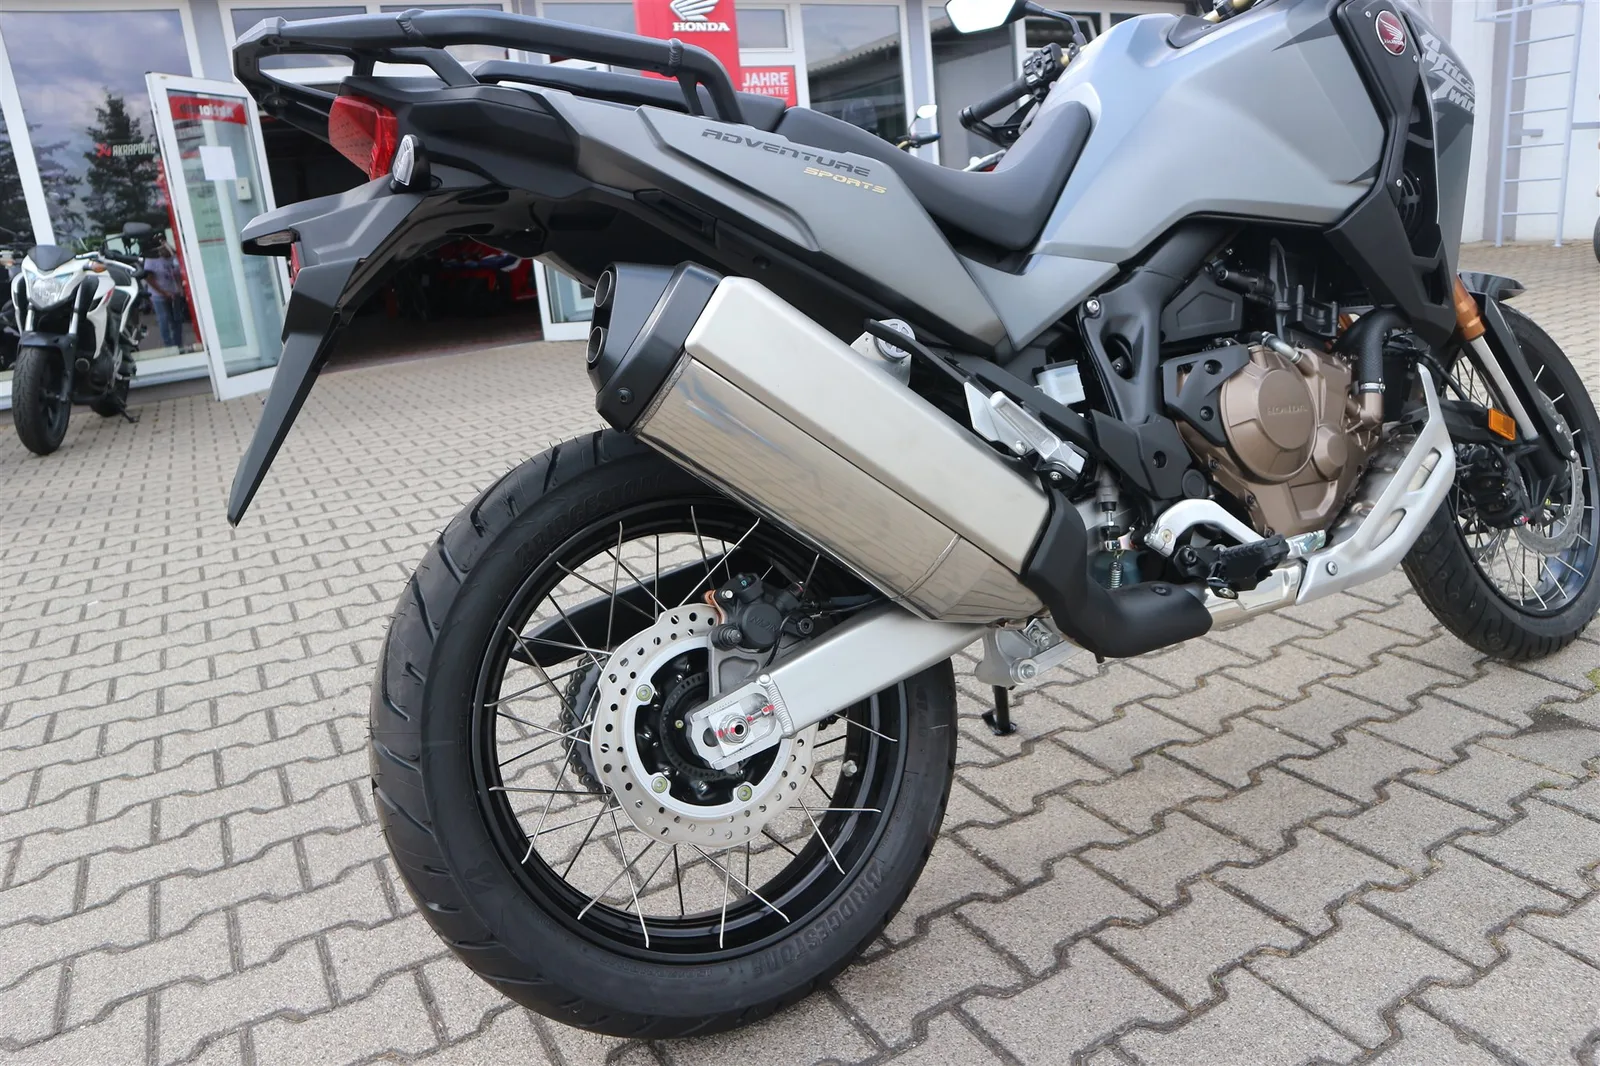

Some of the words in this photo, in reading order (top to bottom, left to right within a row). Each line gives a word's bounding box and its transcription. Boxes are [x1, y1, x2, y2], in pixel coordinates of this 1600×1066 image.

[672, 21, 730, 32] HONDA
[742, 72, 788, 87] JAHRE
[743, 87, 789, 95] GARANTIE
[702, 128, 871, 177] ADVENTURE
[803, 166, 887, 194] SPORTS
[754, 857, 884, 975] BRIDGESTONE
